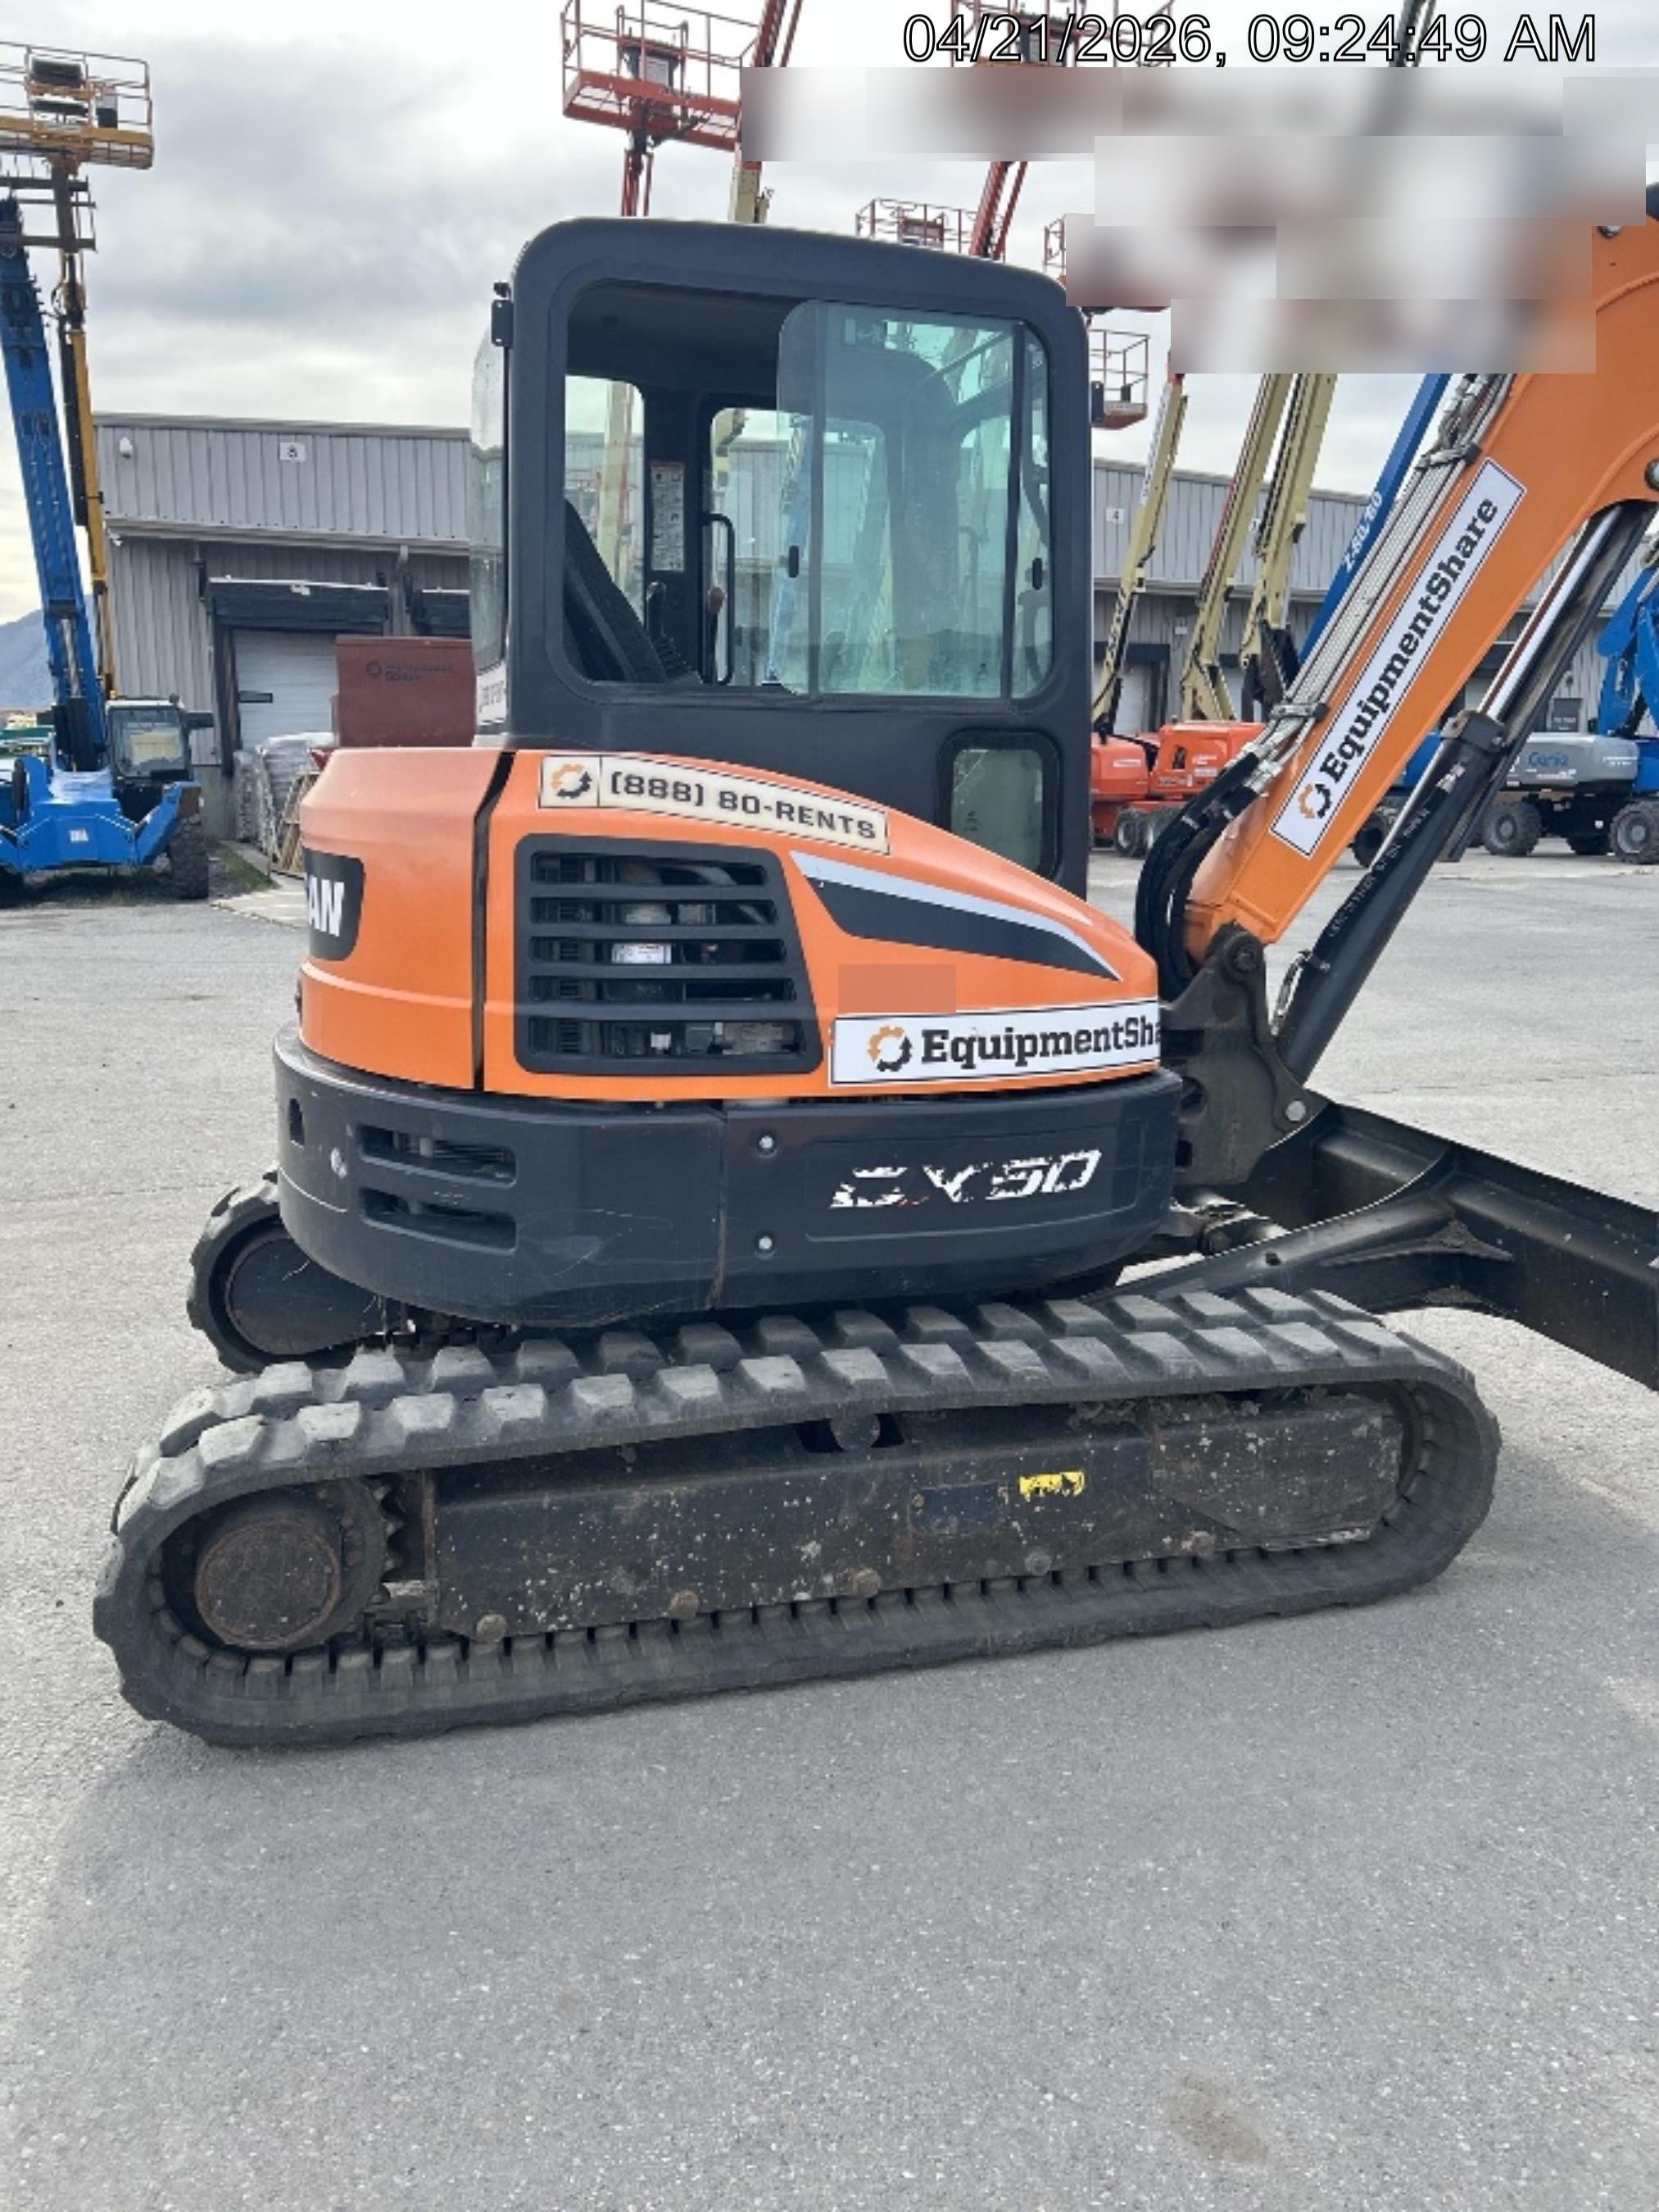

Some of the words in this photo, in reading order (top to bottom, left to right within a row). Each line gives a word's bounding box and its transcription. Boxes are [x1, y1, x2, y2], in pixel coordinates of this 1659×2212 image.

[1319, 497, 1498, 783] EquipmentShare
[610, 770, 705, 807] (888)
[718, 789, 877, 839] 80-RENTS
